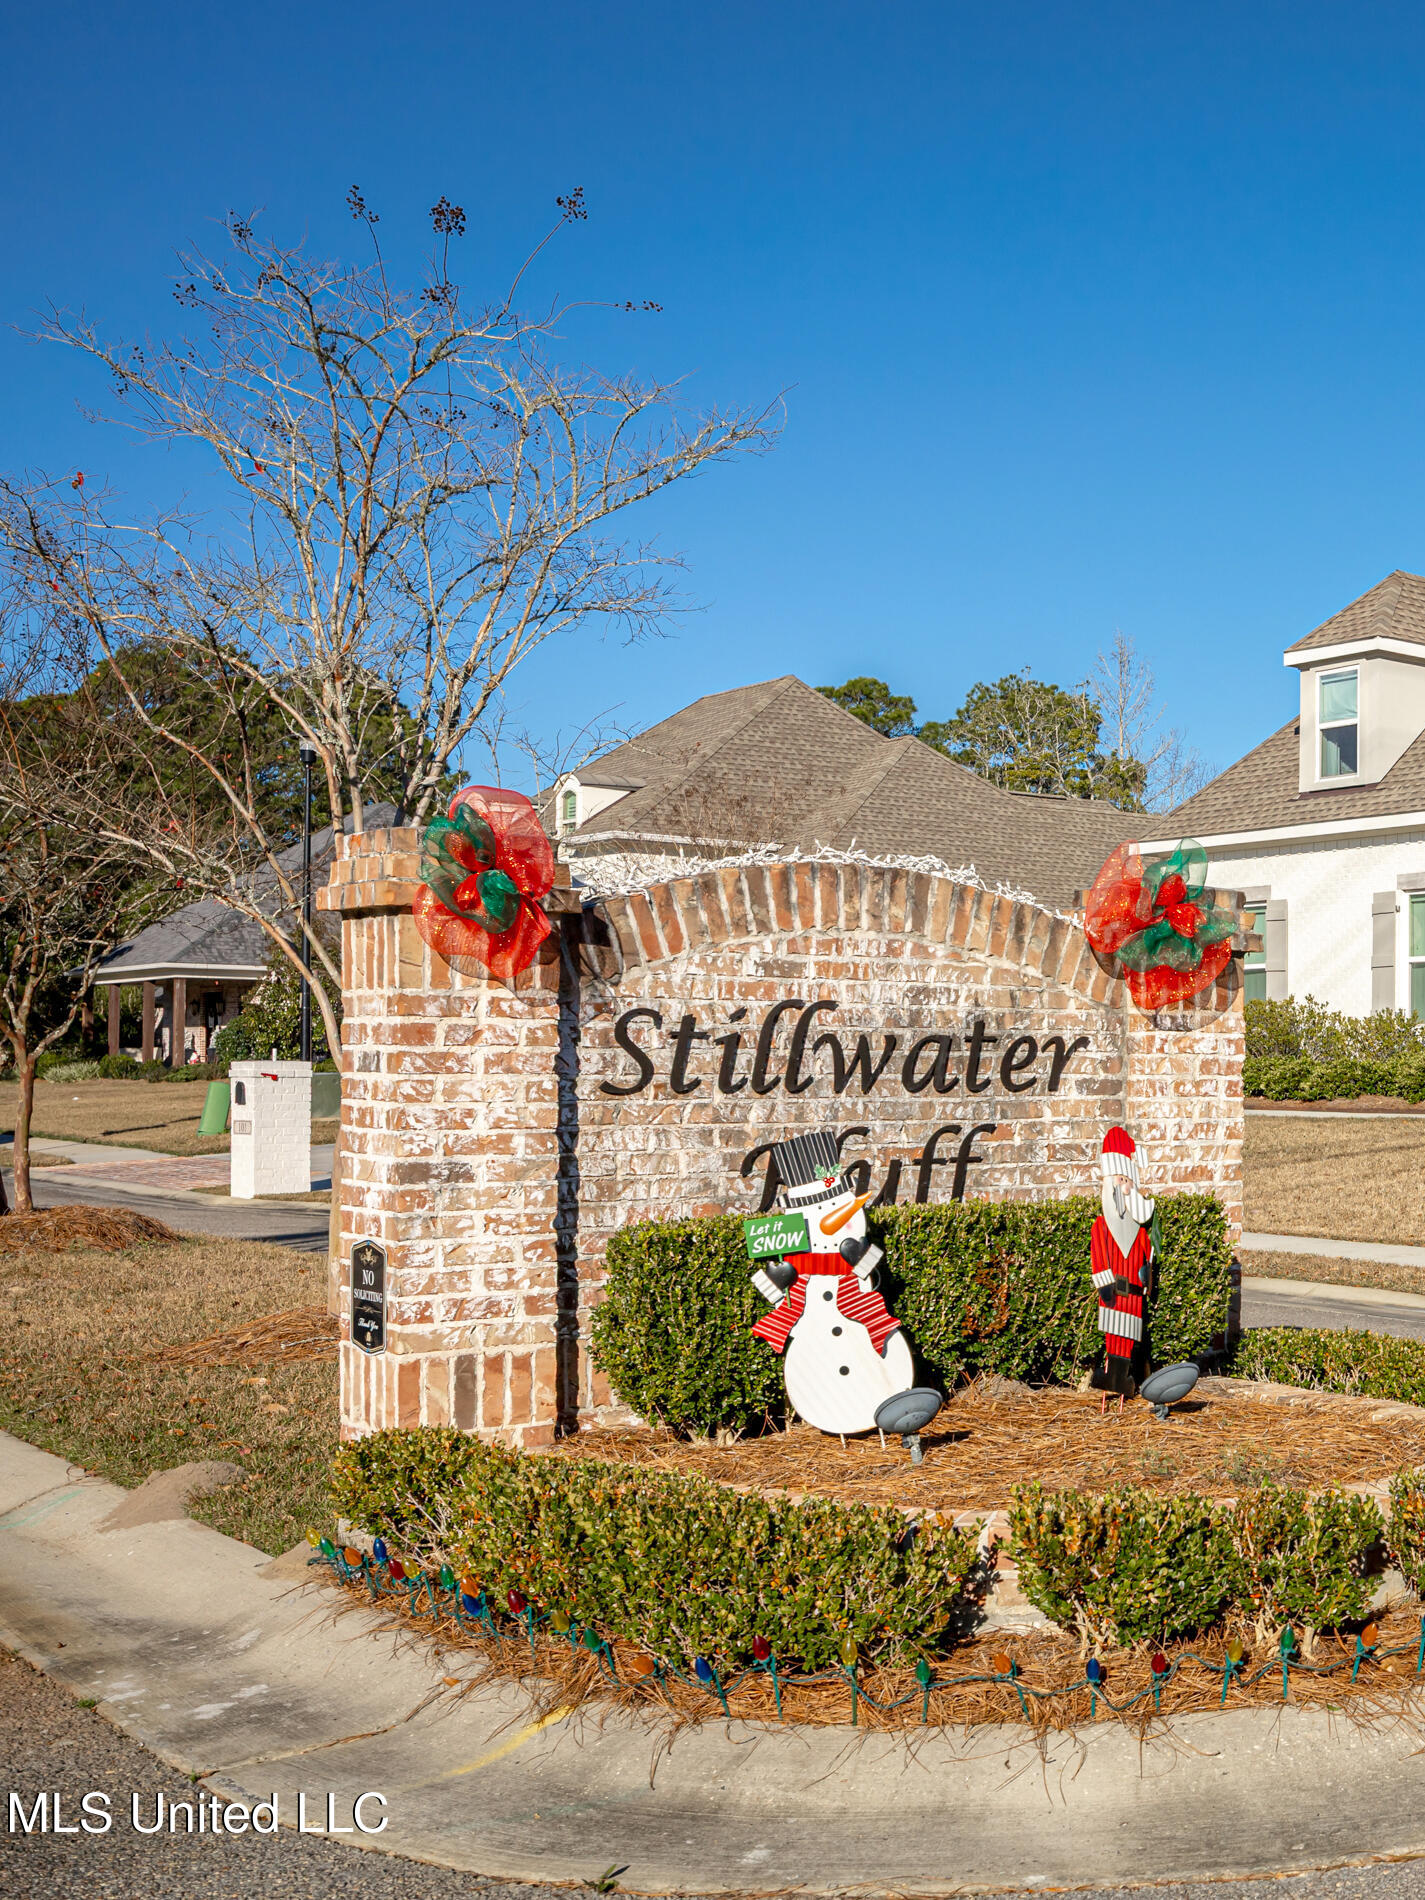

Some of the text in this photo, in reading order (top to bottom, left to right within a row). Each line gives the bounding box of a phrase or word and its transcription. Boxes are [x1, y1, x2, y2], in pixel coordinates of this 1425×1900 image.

[600, 999, 1090, 1095] Stillwater
[750, 1221, 783, 1236] Let it
[752, 1230, 804, 1254] SNOW
[362, 1269, 375, 1286] NO
[353, 1288, 383, 1304] SOLICITING
